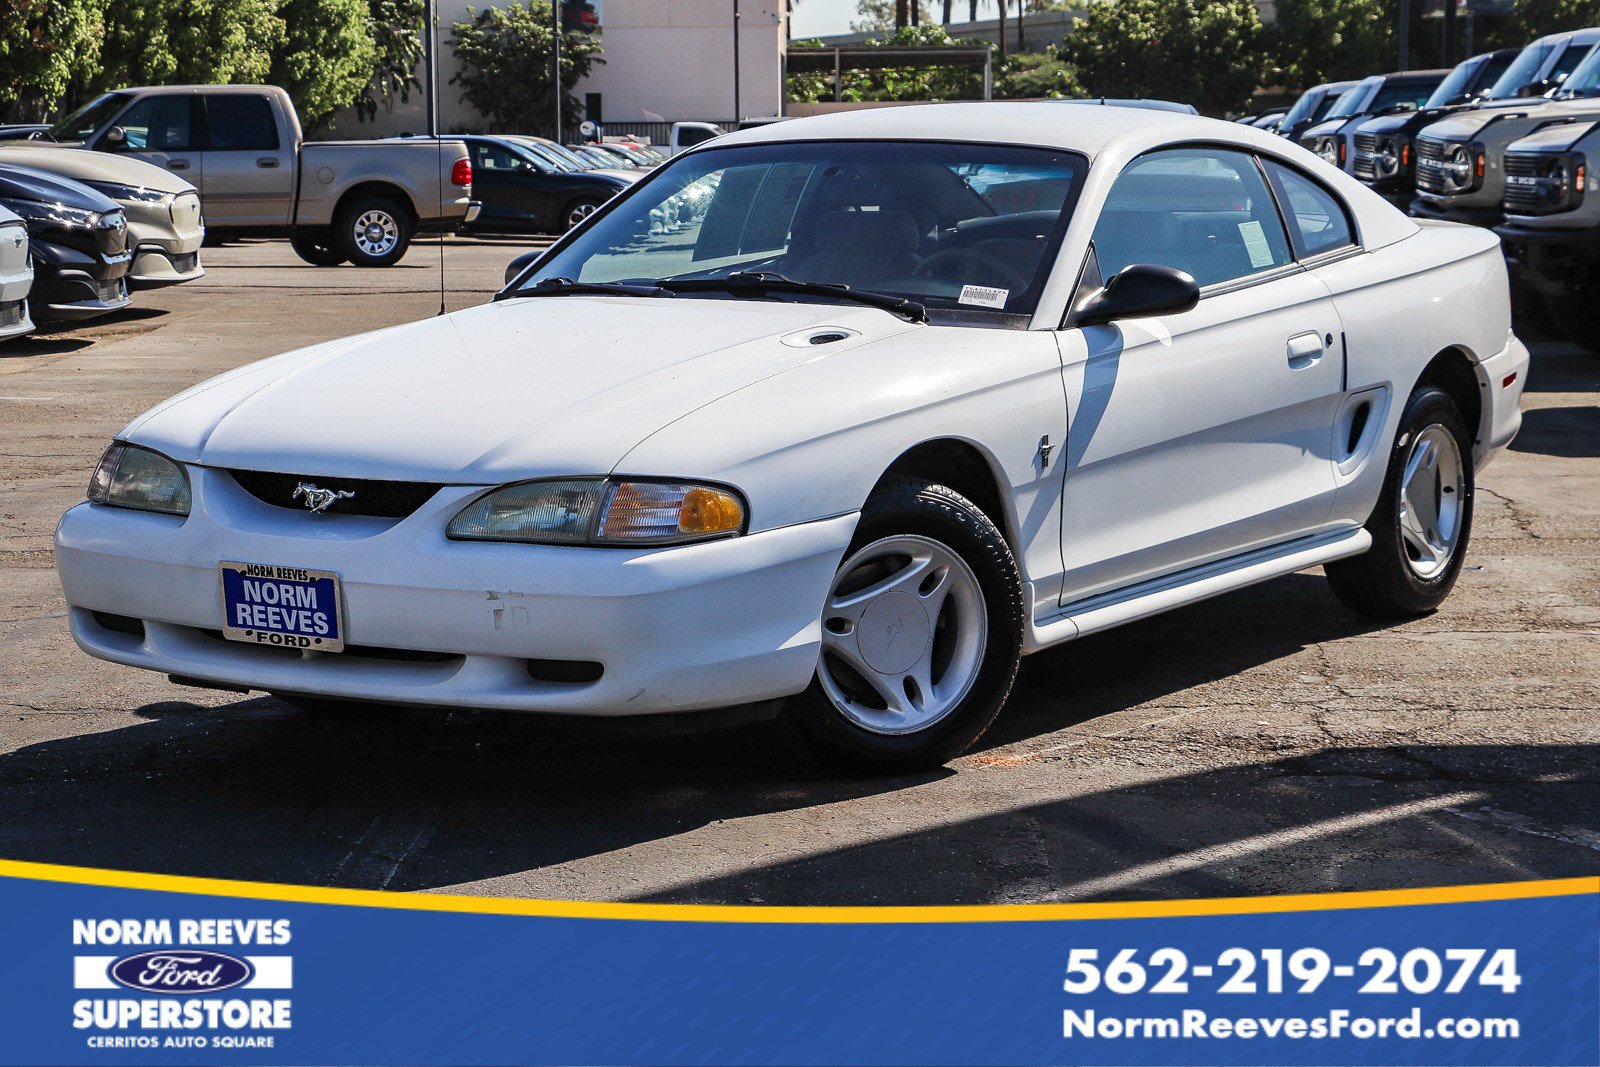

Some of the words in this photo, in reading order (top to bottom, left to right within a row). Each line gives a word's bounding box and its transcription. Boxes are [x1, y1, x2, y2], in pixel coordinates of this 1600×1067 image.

[246, 564, 274, 578] NORM
[276, 567, 308, 581] REEVES
[243, 580, 318, 609] NORM
[236, 603, 329, 635] REEVES
[256, 631, 311, 648] FORD
